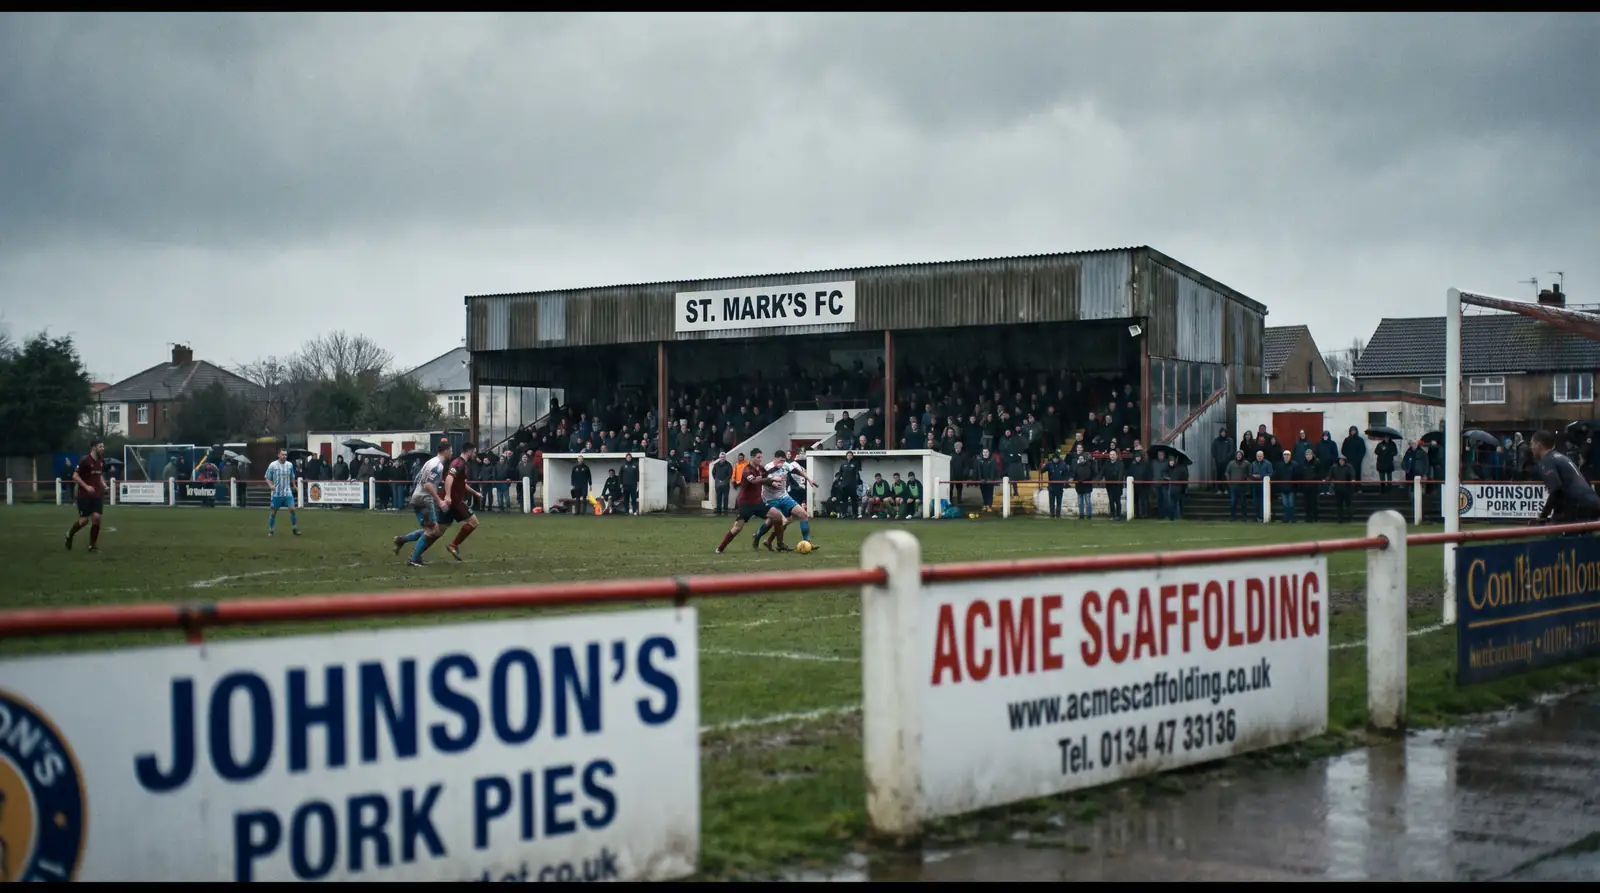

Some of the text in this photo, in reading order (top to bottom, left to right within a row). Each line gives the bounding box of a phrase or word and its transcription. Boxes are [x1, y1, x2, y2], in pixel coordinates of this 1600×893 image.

[686, 290, 844, 323] ST. MARK'S FC
[1477, 486, 1548, 499] JOHNSON'
[1486, 500, 1517, 511] PORK
[931, 571, 1321, 686] ACME SCAFFOLDING
[133, 635, 681, 794] JOHNSON'S
[1008, 657, 1272, 731] www.acmescaffolding.co.uk
[1058, 708, 1237, 775] Tel. 0134 47 33136
[233, 759, 619, 882] PORK PIES
